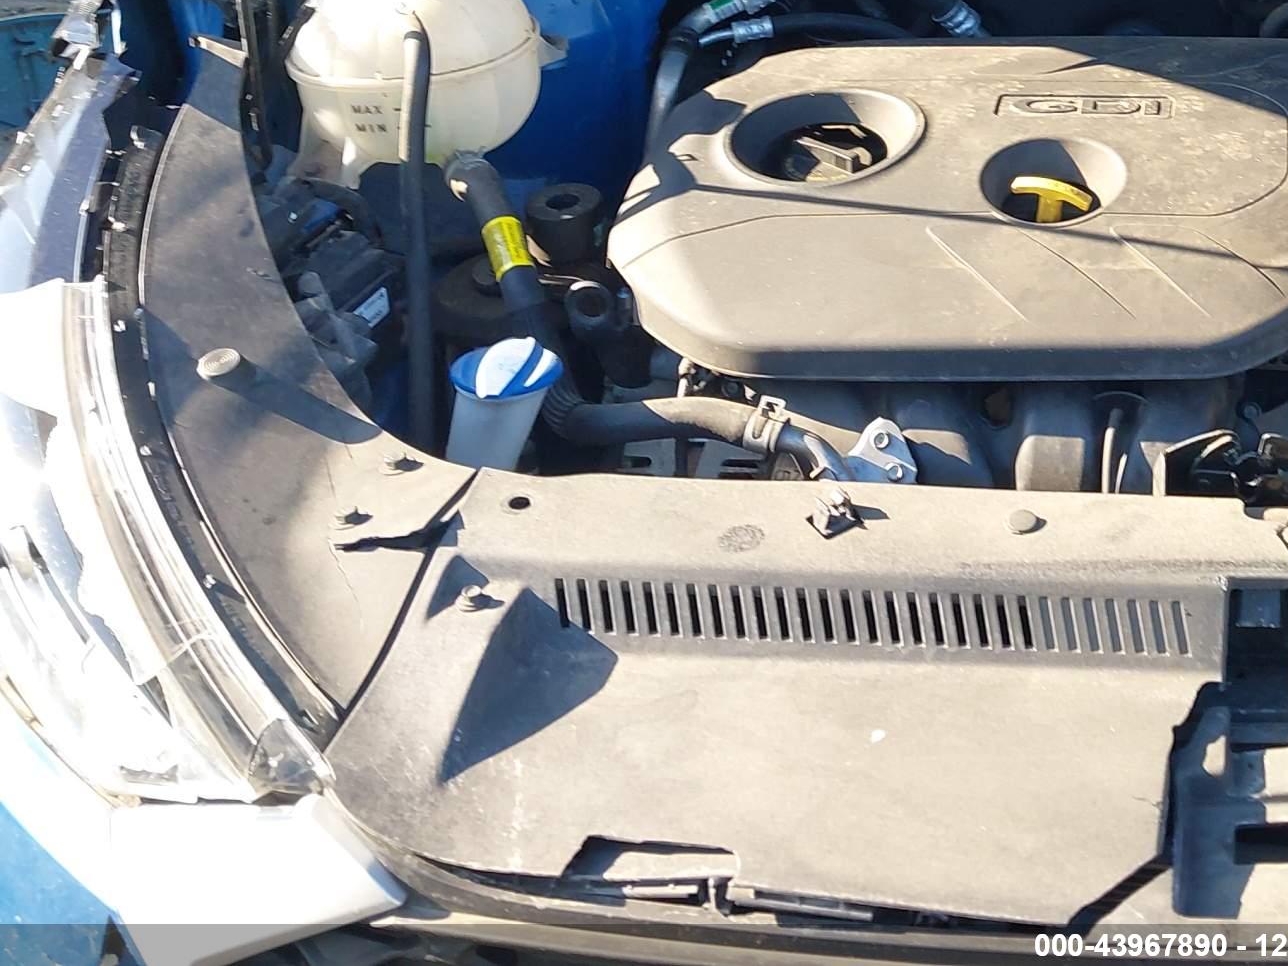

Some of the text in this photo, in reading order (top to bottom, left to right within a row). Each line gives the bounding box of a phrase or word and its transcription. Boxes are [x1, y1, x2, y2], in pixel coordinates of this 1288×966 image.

[351, 105, 383, 114] MAX
[1010, 98, 1162, 115] GDI
[355, 124, 387, 133] MIN
